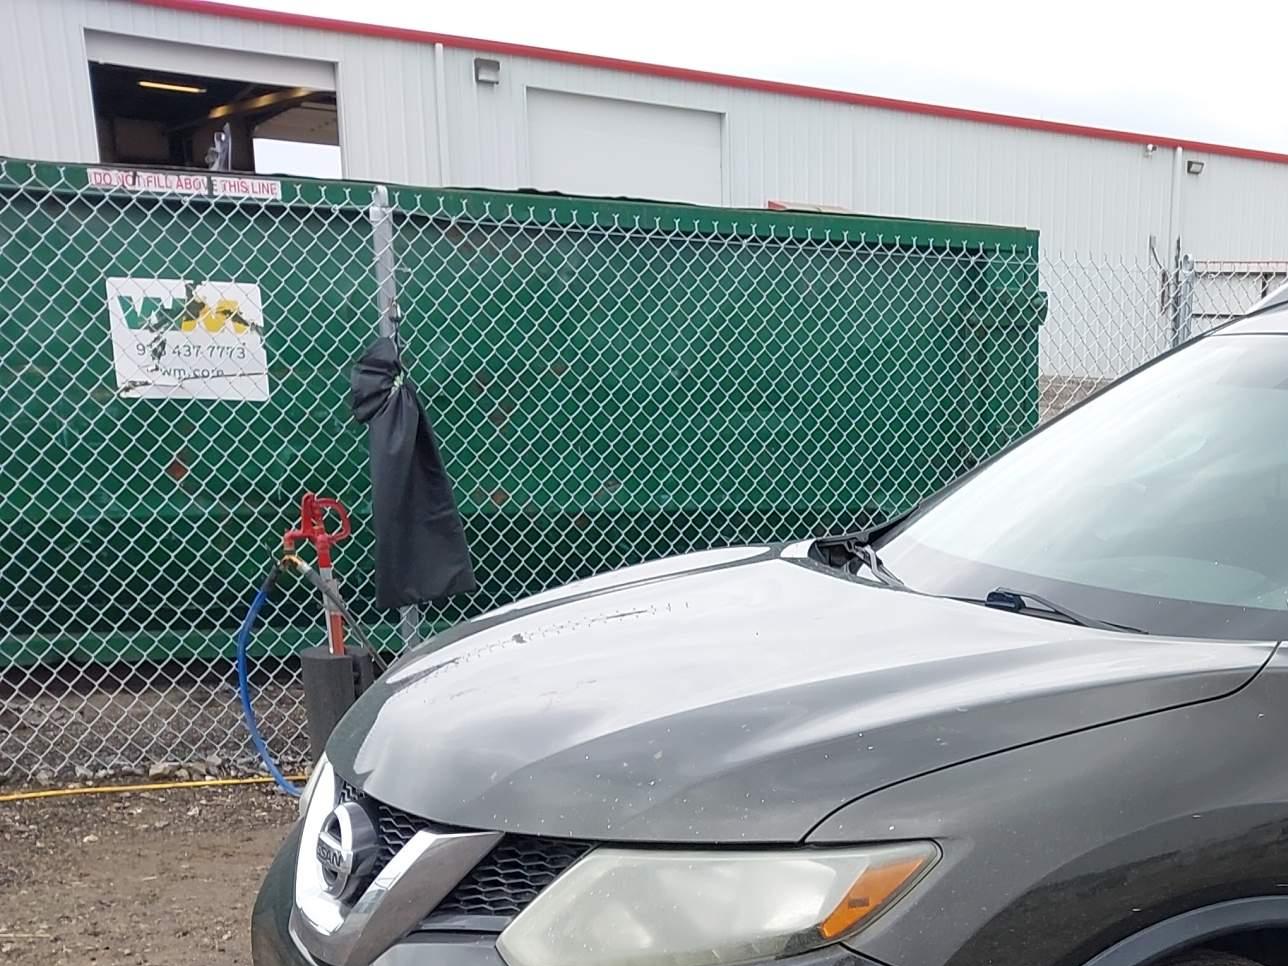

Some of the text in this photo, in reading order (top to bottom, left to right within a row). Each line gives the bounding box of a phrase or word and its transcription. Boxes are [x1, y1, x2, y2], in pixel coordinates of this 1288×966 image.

[93, 171, 277, 196] DO NOT FILL ABOVE THIS LINE
[172, 344, 201, 358] 437
[207, 344, 246, 359] 7773
